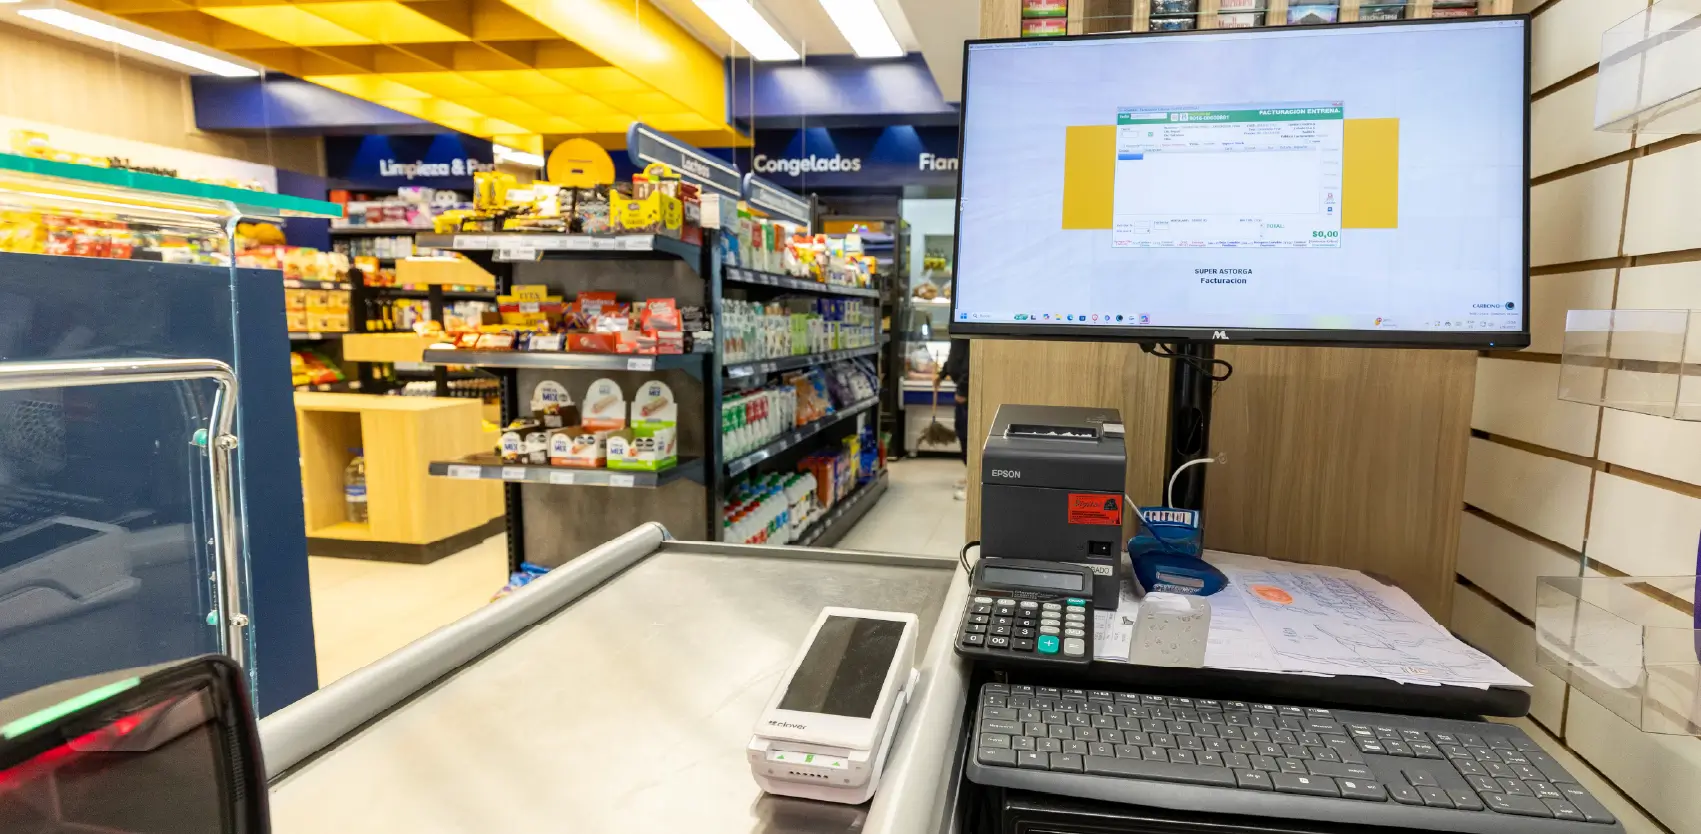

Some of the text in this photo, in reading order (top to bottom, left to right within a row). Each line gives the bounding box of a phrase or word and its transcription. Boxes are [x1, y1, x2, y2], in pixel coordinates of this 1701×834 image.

[380, 158, 450, 180] Limpieza
[451, 158, 466, 176] &
[753, 154, 861, 177] Congelados
[991, 469, 1021, 478] EPSON
[777, 721, 807, 730] clover
